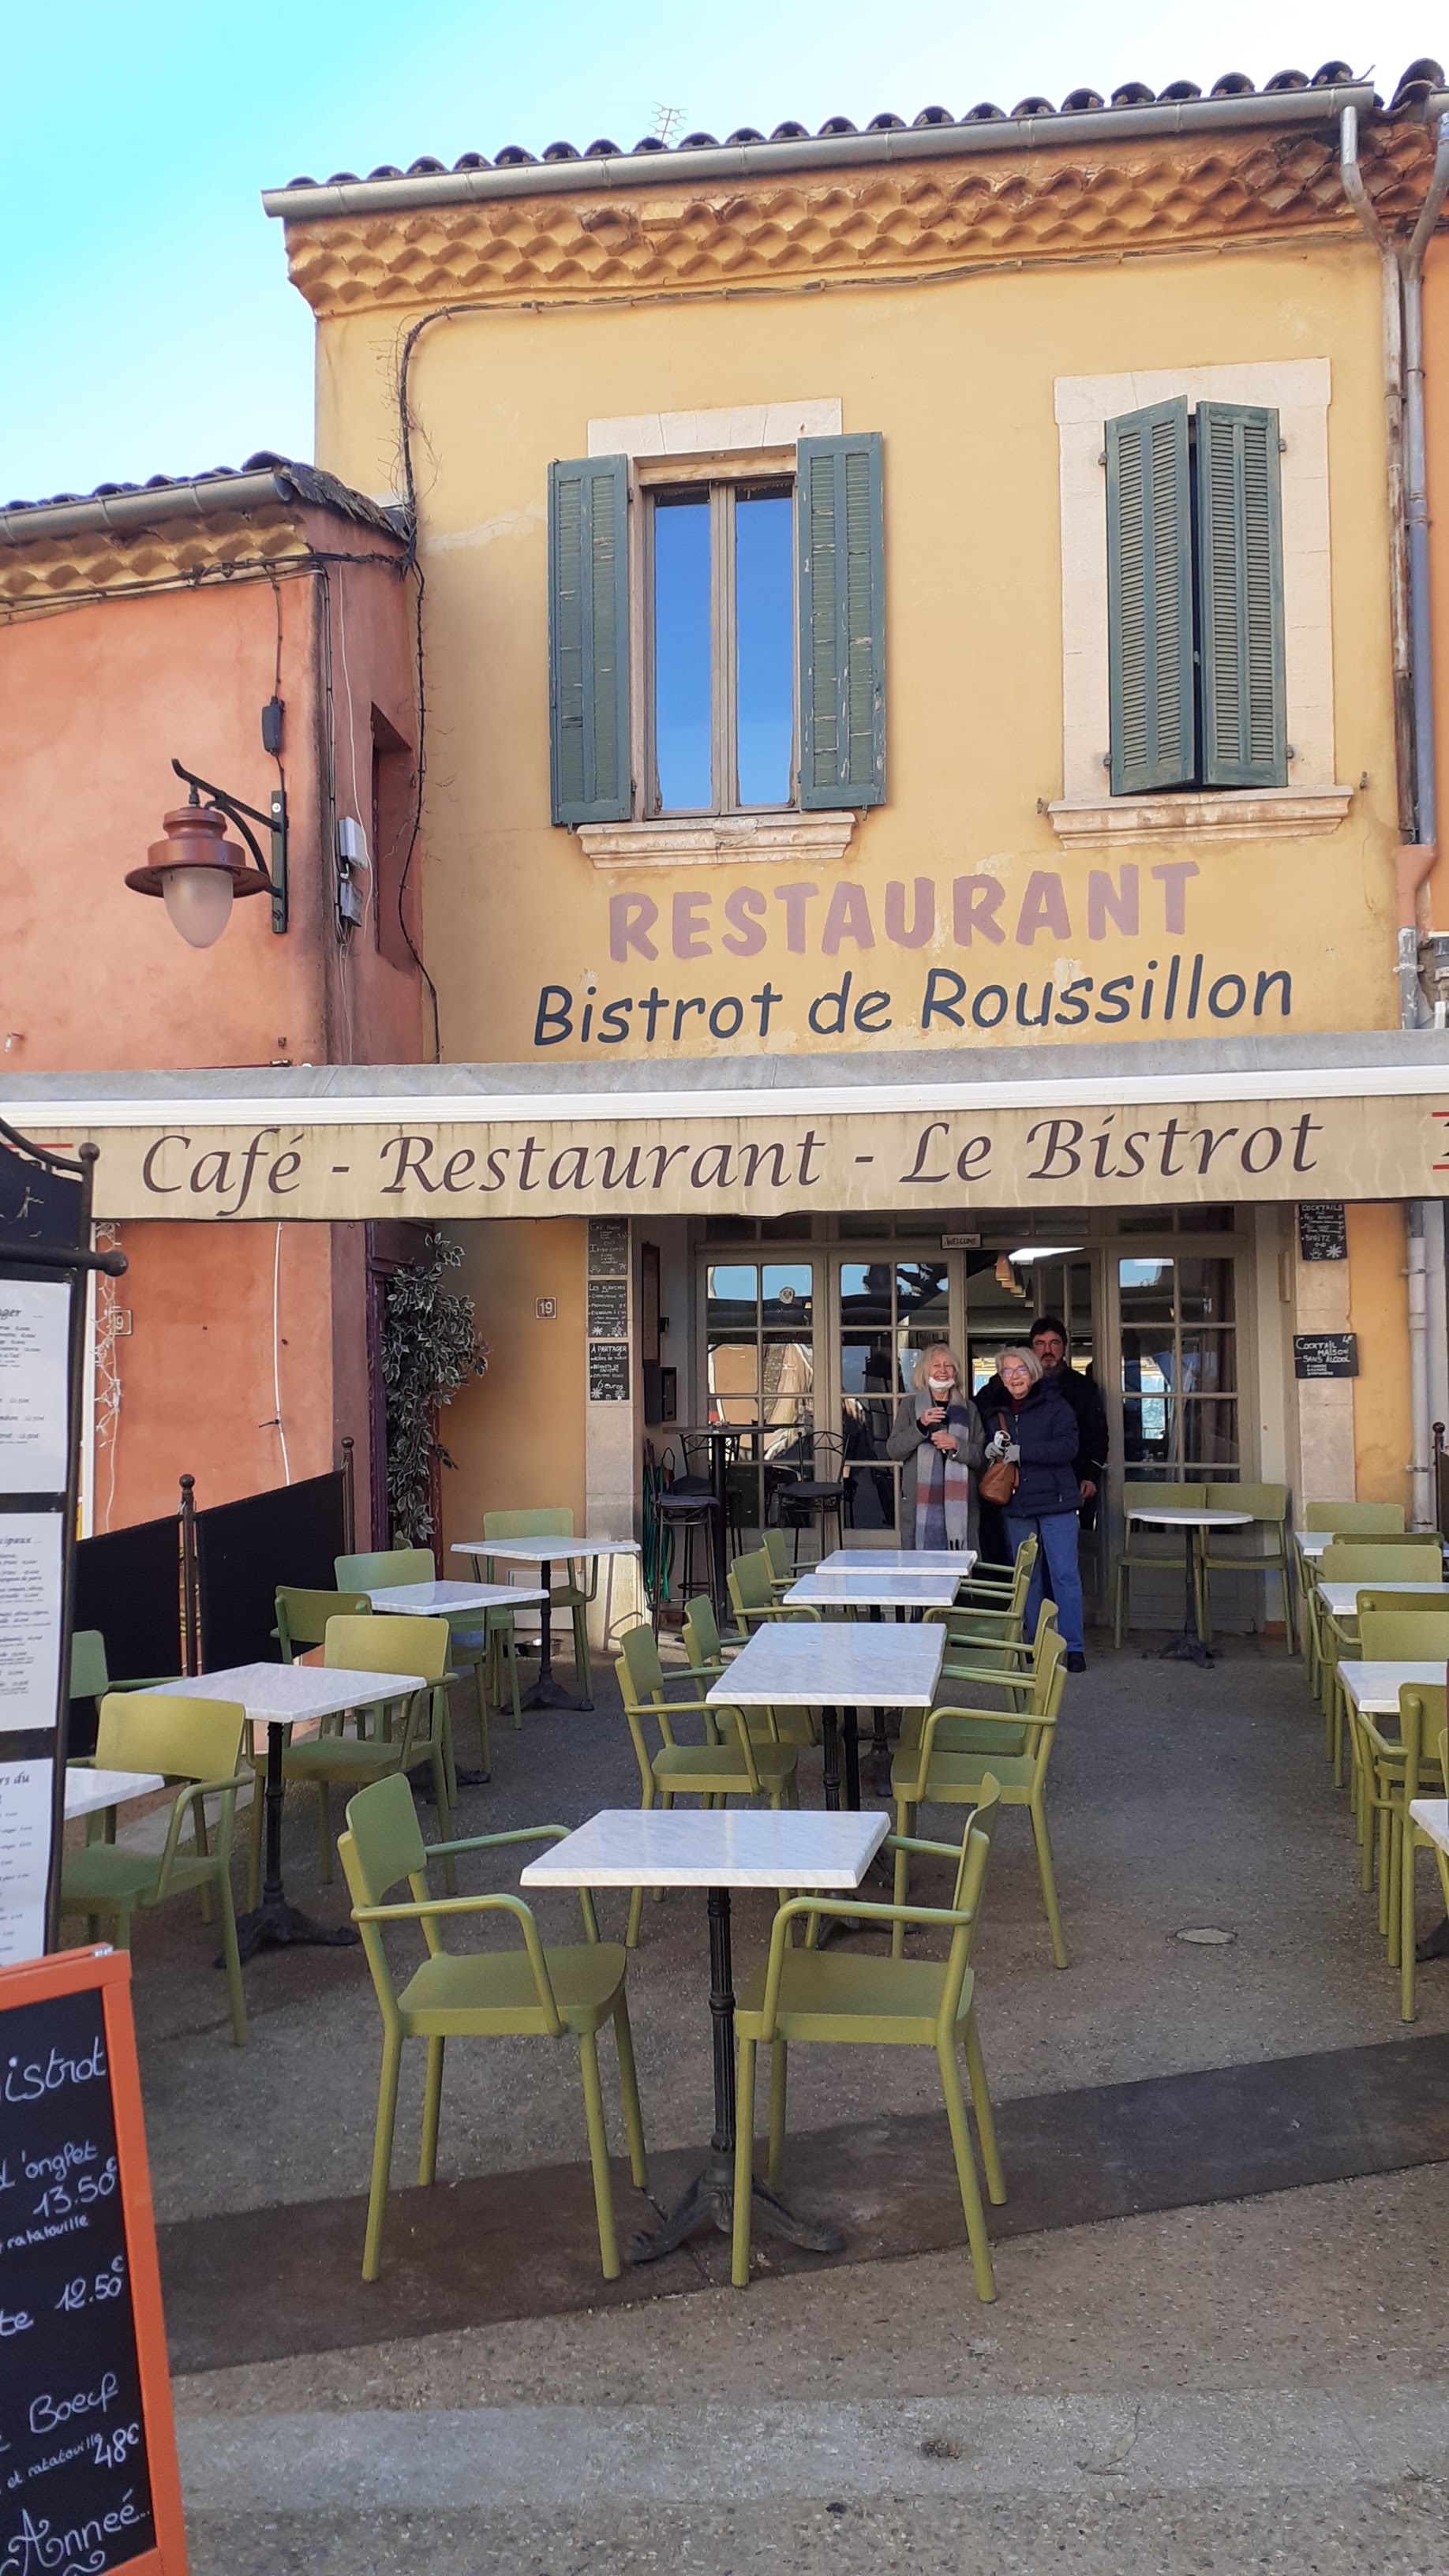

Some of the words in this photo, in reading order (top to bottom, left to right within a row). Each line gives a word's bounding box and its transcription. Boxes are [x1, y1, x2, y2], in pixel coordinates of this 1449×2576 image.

[608, 861, 1200, 964] RESTAURANT
[533, 981, 784, 1046] Bistrot
[807, 970, 893, 1035] de
[920, 953, 1293, 1029] Roussillon
[142, 1127, 305, 1217] Café
[379, 1131, 826, 1193] Restaurant
[898, 1121, 992, 1183] Le
[1025, 1112, 1324, 1180] Bistrot
[946, 1237, 977, 1246] WELCOME
[540, 1301, 553, 1314] 19
[1302, 1354, 1324, 1364] SANS
[1325, 1354, 1351, 1364] ALCOOL
[597, 1379, 604, 1388] 6
[13, 1770, 30, 1784] du
[5, 2035, 107, 2102] istrot
[29, 2371, 119, 2433] Boeuf
